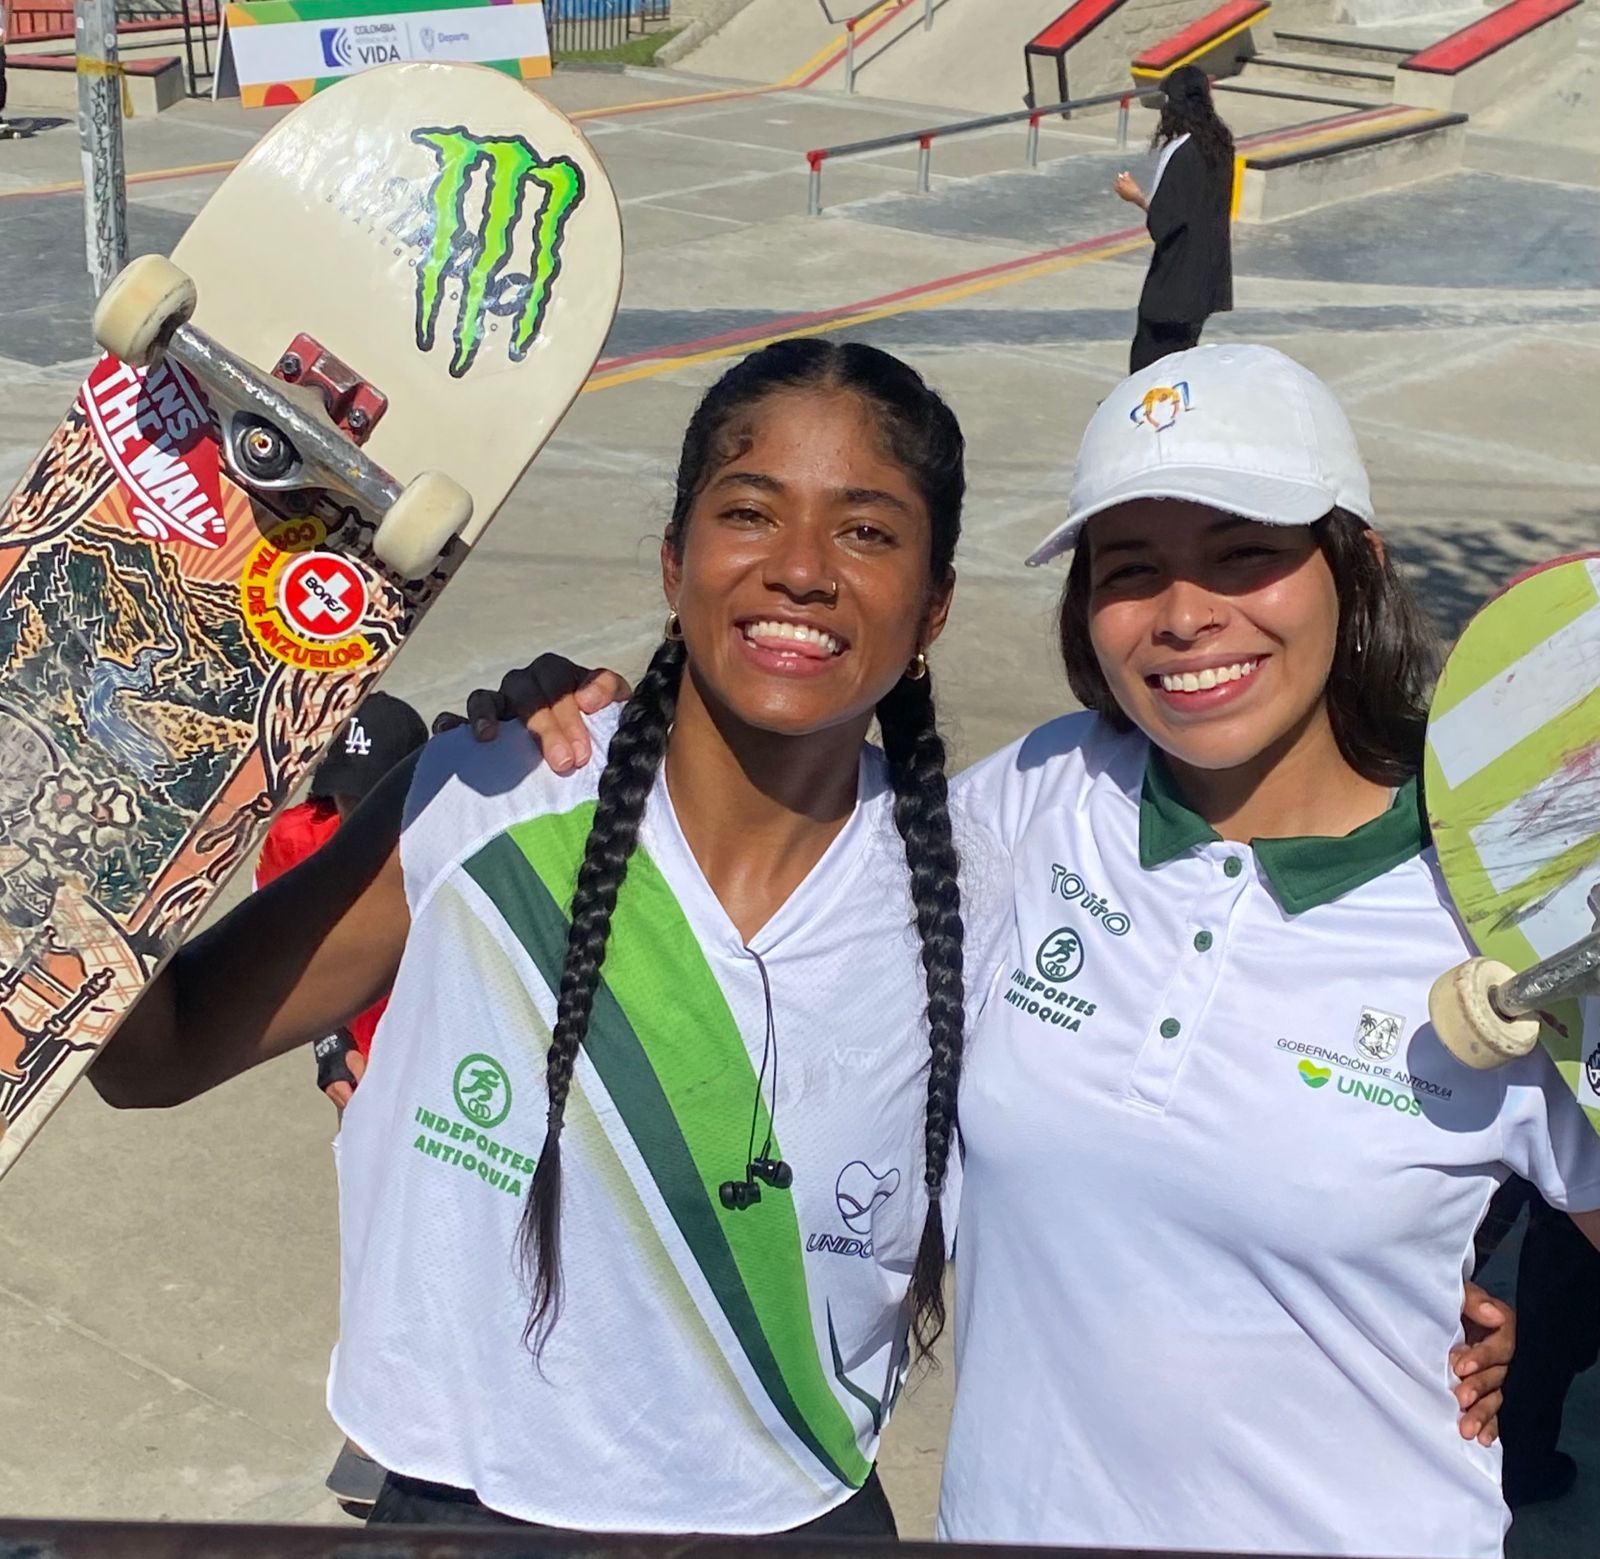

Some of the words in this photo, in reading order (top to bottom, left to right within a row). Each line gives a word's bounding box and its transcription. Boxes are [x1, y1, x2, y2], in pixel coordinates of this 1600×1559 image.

[357, 44, 401, 64] VIDA
[92, 360, 163, 454] THE
[247, 586, 268, 616] DE
[305, 576, 346, 613] BONES
[254, 620, 365, 668] ANZUELOS
[345, 717, 372, 756] LA
[1003, 988, 1082, 1032] ANTIOQUIA
[1276, 1038, 1370, 1072] GOBERNACIÓN
[1373, 1065, 1391, 1077] DE
[1394, 1071, 1453, 1099] ANTIOQUIA
[1336, 1074, 1422, 1117] UNIDOS
[414, 1106, 537, 1175] INDEPORTES
[413, 1134, 522, 1197] ANTIOQUIA
